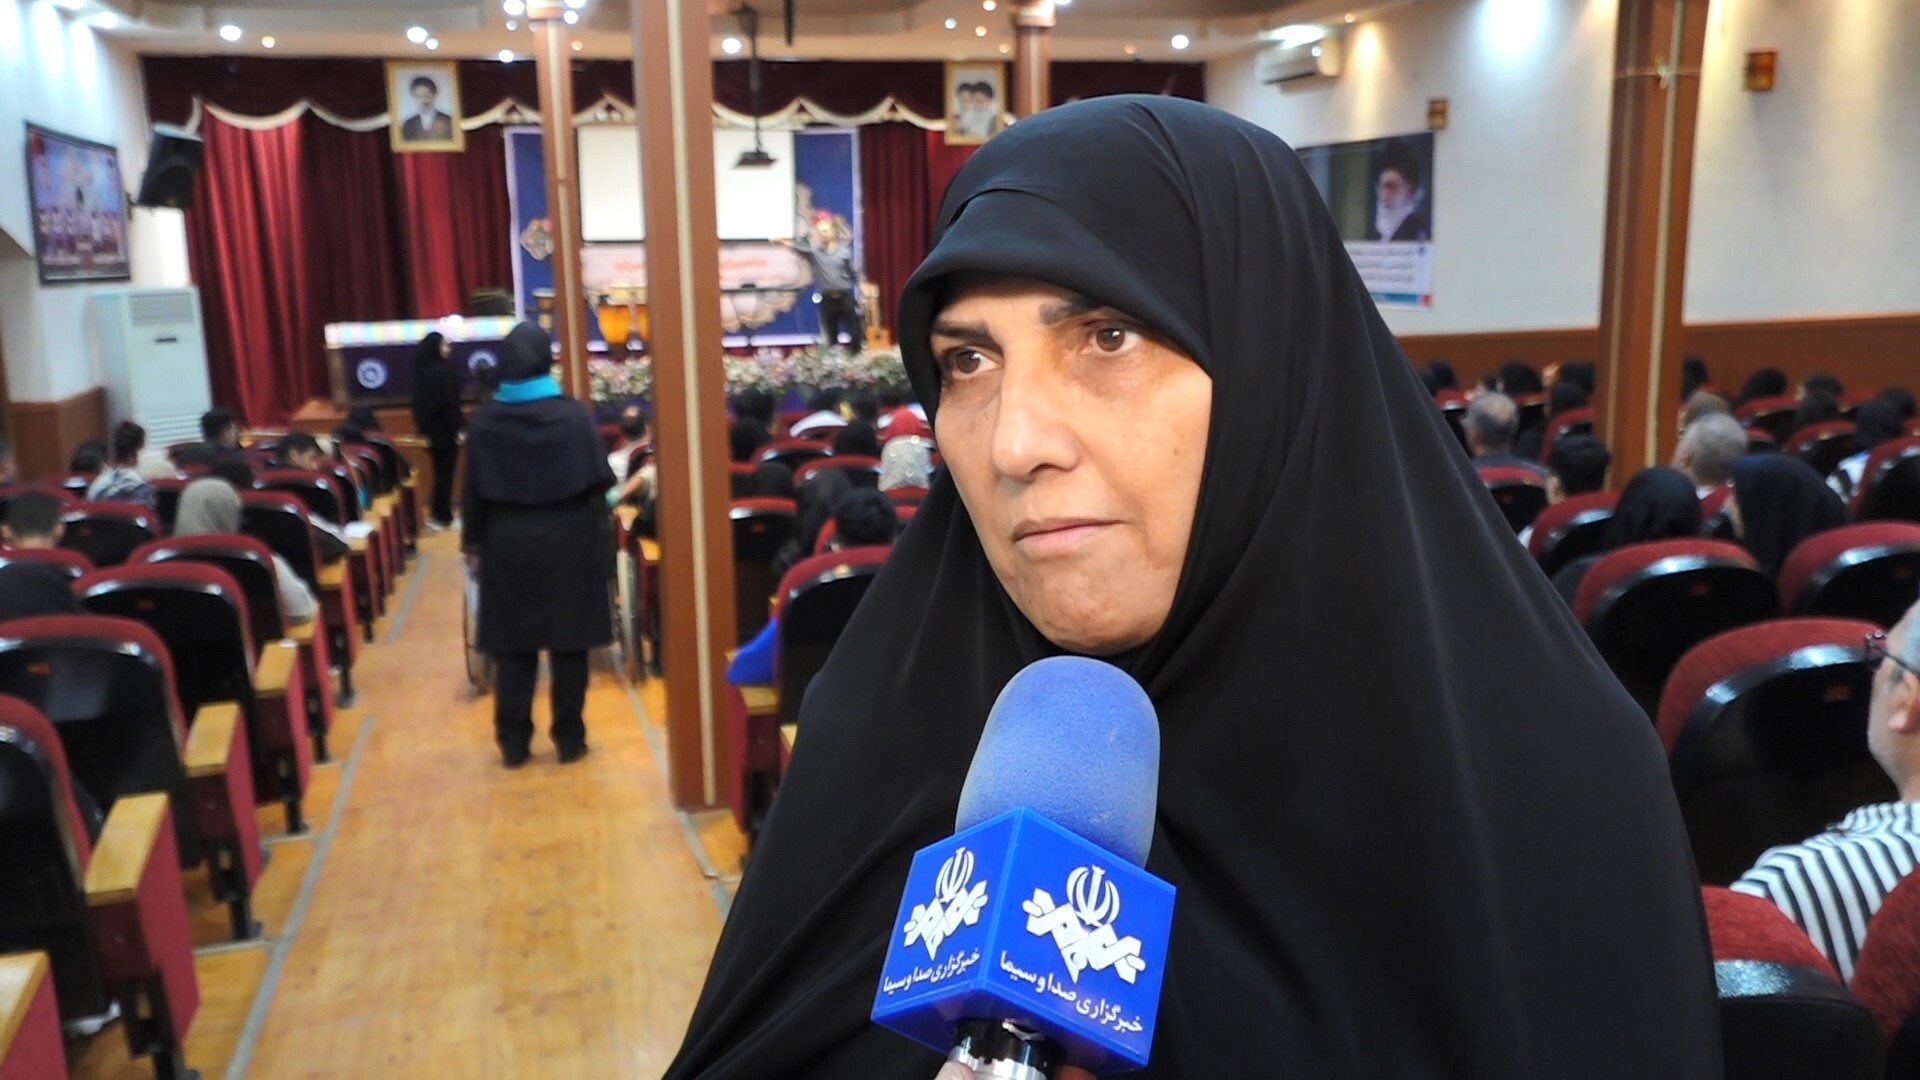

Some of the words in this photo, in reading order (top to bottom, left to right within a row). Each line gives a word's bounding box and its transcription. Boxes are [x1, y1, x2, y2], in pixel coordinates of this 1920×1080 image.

[913, 966, 933, 982] صدا
[930, 947, 980, 983] خبرگزاری
[1000, 950, 1037, 983] سیما
[883, 976, 906, 995] سیما
[903, 974, 912, 991] و
[1035, 976, 1046, 993] و
[1048, 972, 1077, 1001] صدا
[1075, 998, 1143, 1033] خبرگزاری
